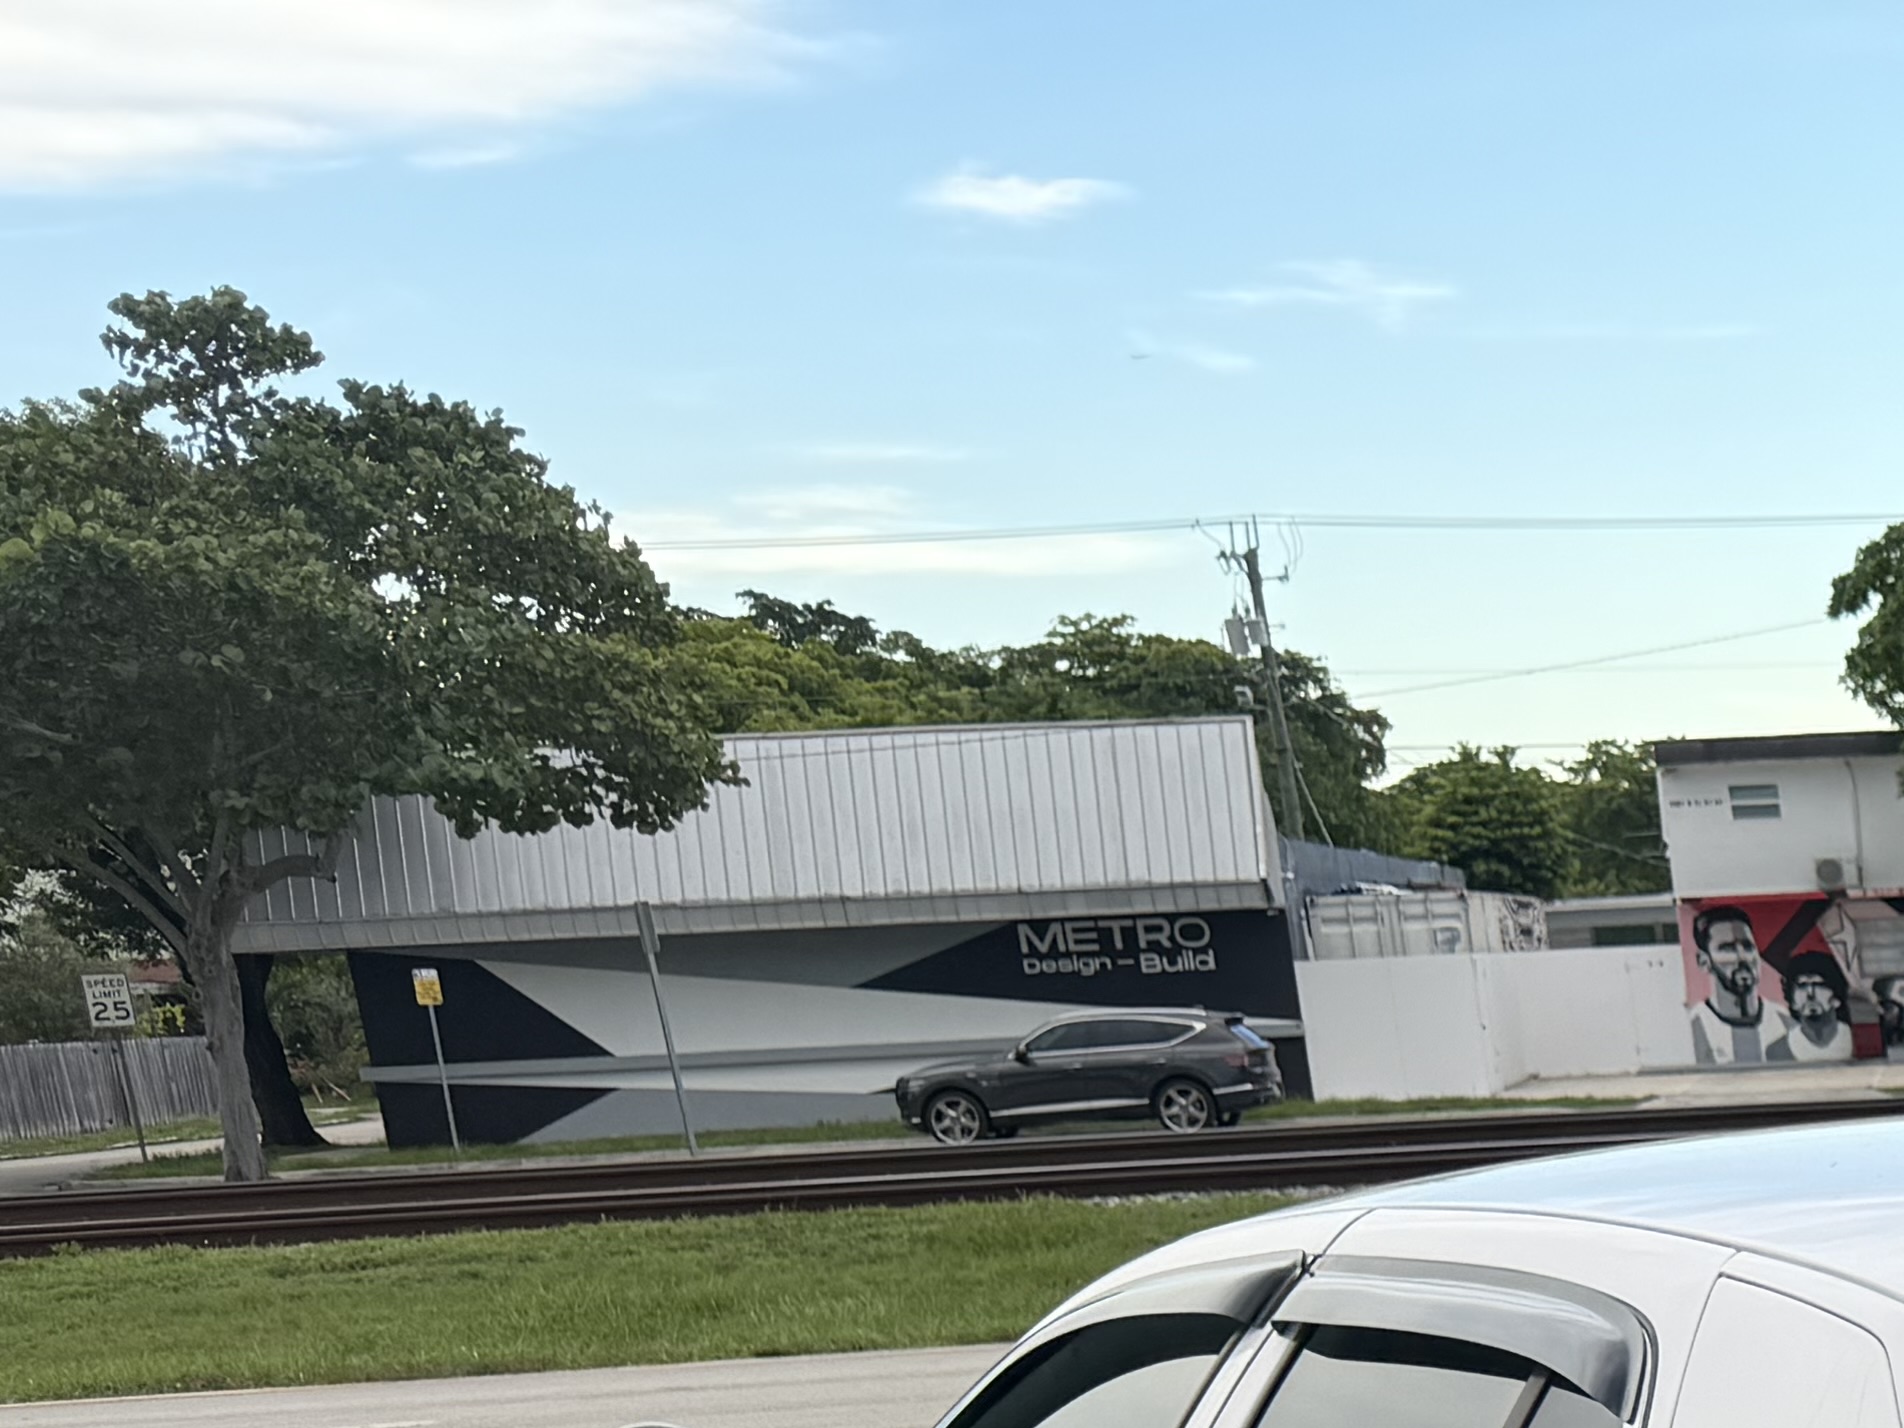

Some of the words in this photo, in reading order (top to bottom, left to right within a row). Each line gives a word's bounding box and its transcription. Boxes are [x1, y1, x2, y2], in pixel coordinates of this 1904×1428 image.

[1016, 916, 1211, 954] METRO
[1022, 952, 1113, 976] Design
[1139, 948, 1217, 974] Build
[86, 978, 125, 989] SPEED
[92, 989, 121, 999] LIMIT
[92, 1001, 130, 1021] 25
